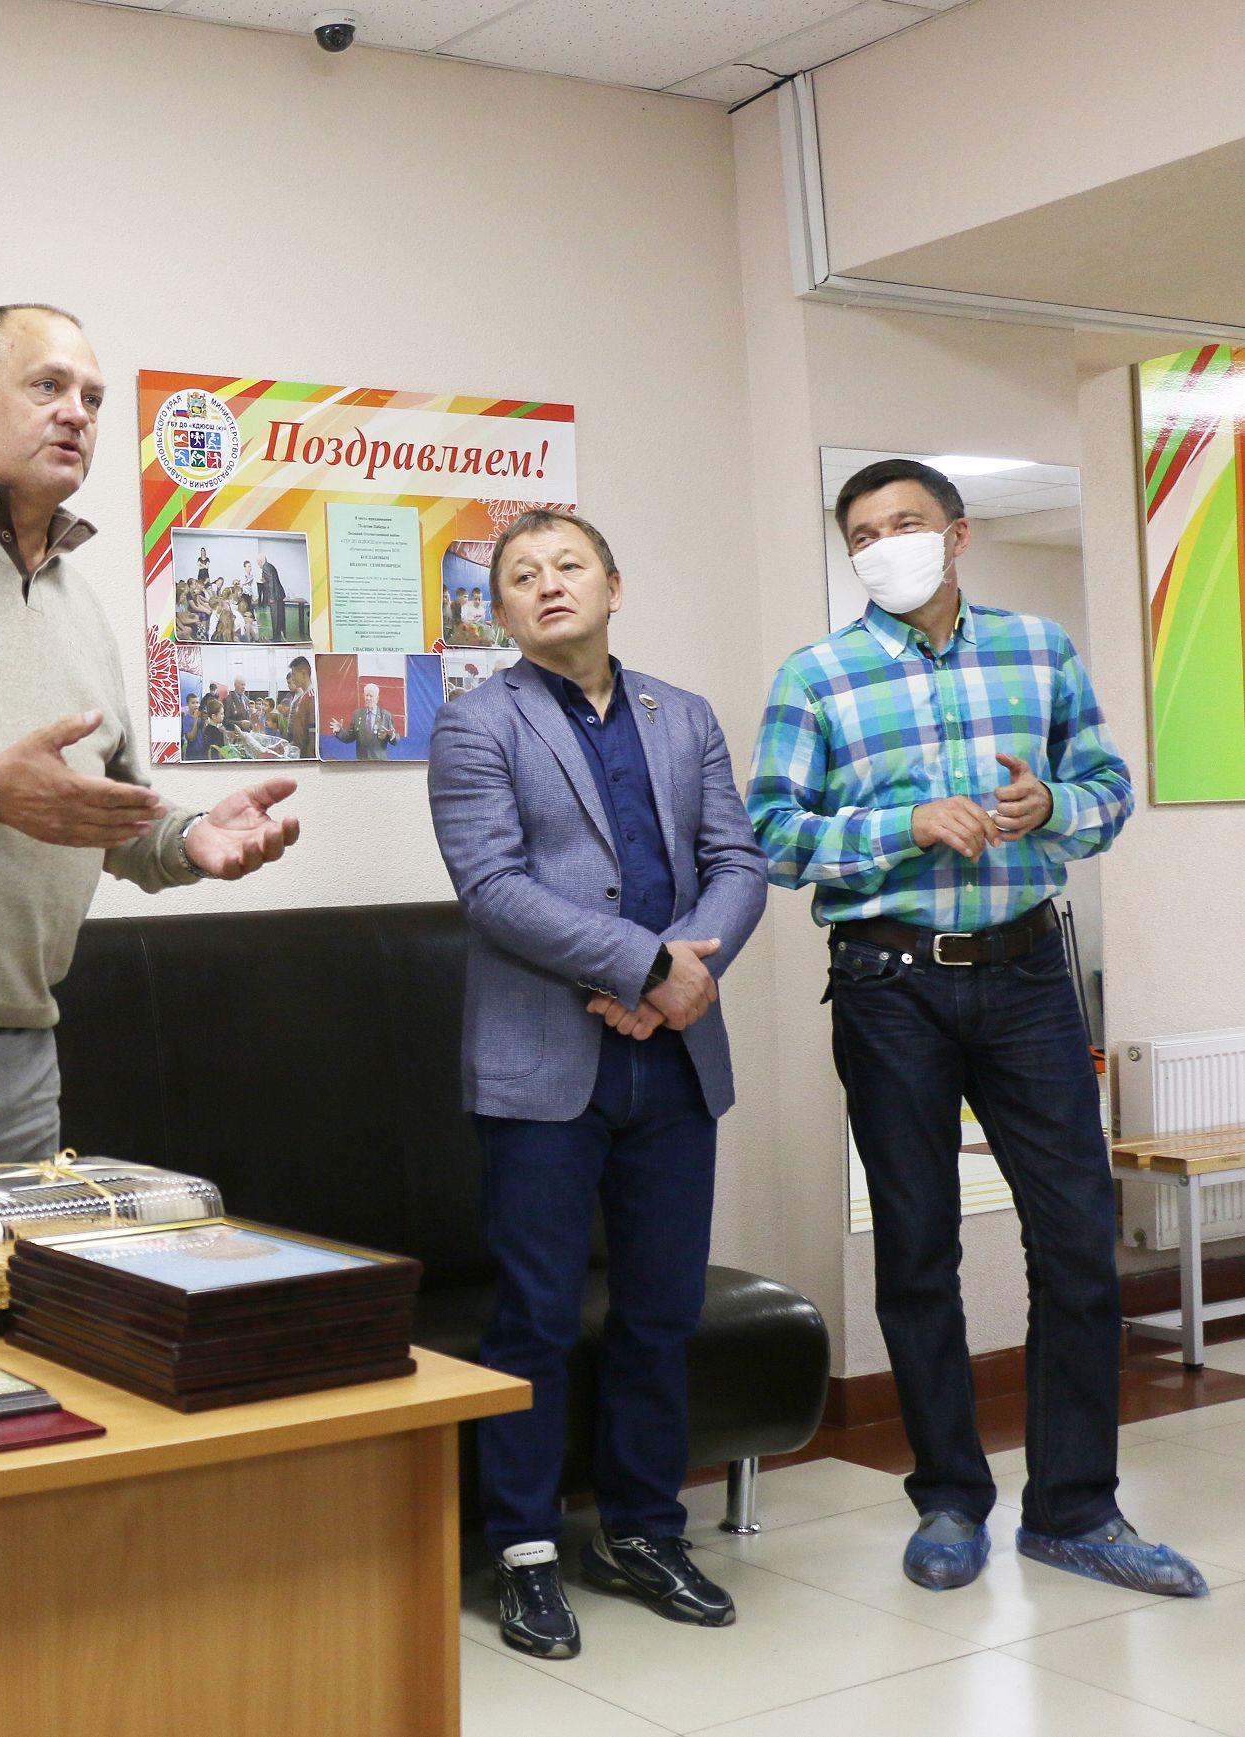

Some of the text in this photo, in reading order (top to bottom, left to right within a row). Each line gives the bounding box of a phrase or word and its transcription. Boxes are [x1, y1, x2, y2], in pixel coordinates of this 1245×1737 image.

[156, 395, 239, 488] МИНИСТЕРСТВО ОБРАЗОВАНИЯ СТАВРОПОЛЬСКОГО КРАЯ
[260, 420, 549, 481] Поздравляем!
